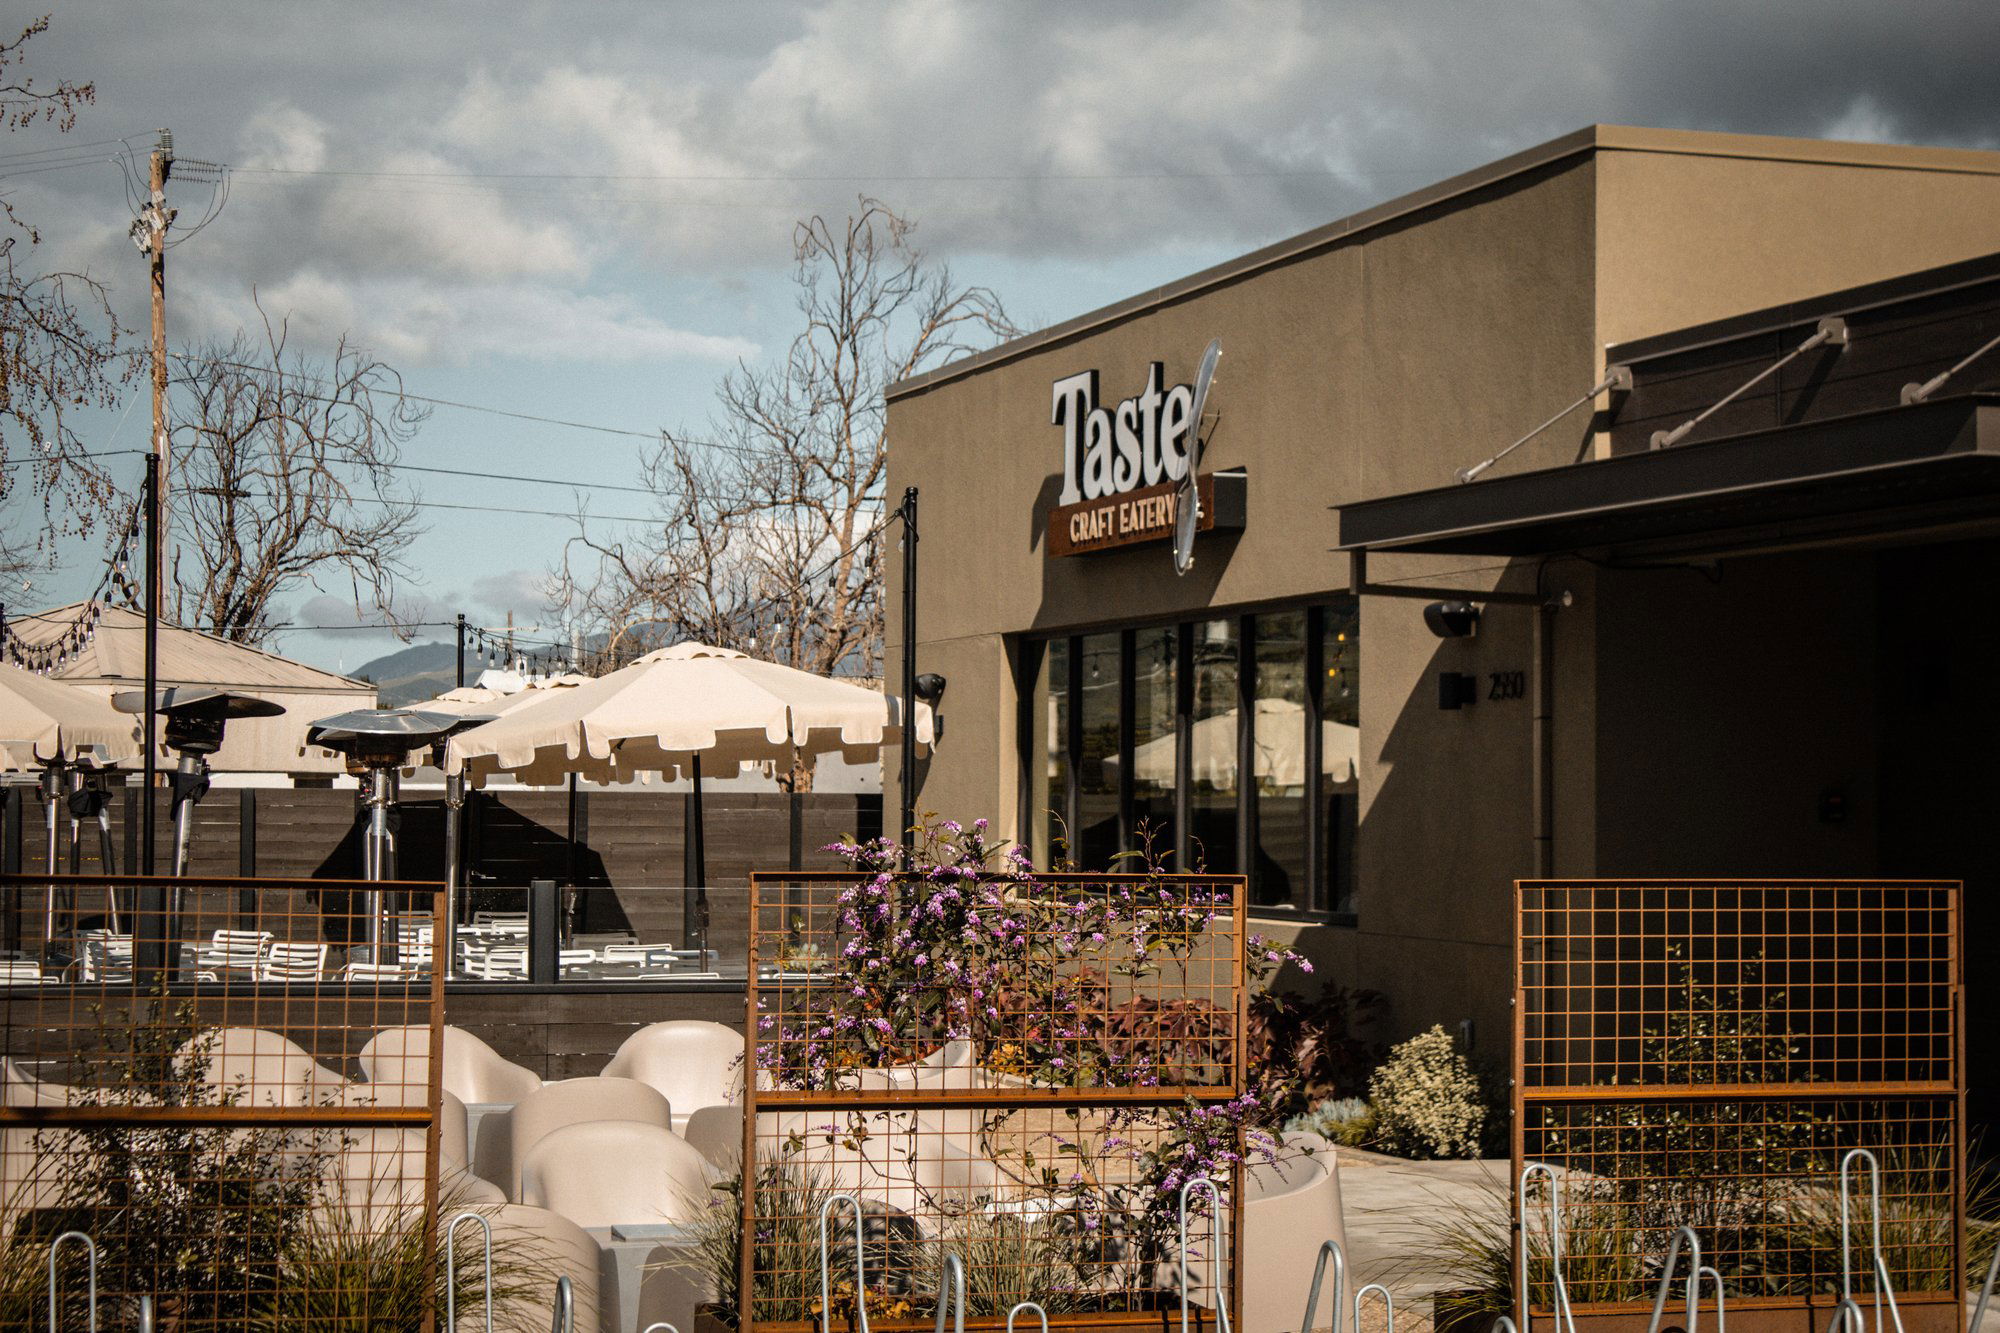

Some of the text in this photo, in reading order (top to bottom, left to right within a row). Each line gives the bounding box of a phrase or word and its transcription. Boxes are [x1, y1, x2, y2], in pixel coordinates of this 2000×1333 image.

[1052, 362, 1195, 506] Taste
[1070, 493, 1176, 543] CRAFT EATERY
